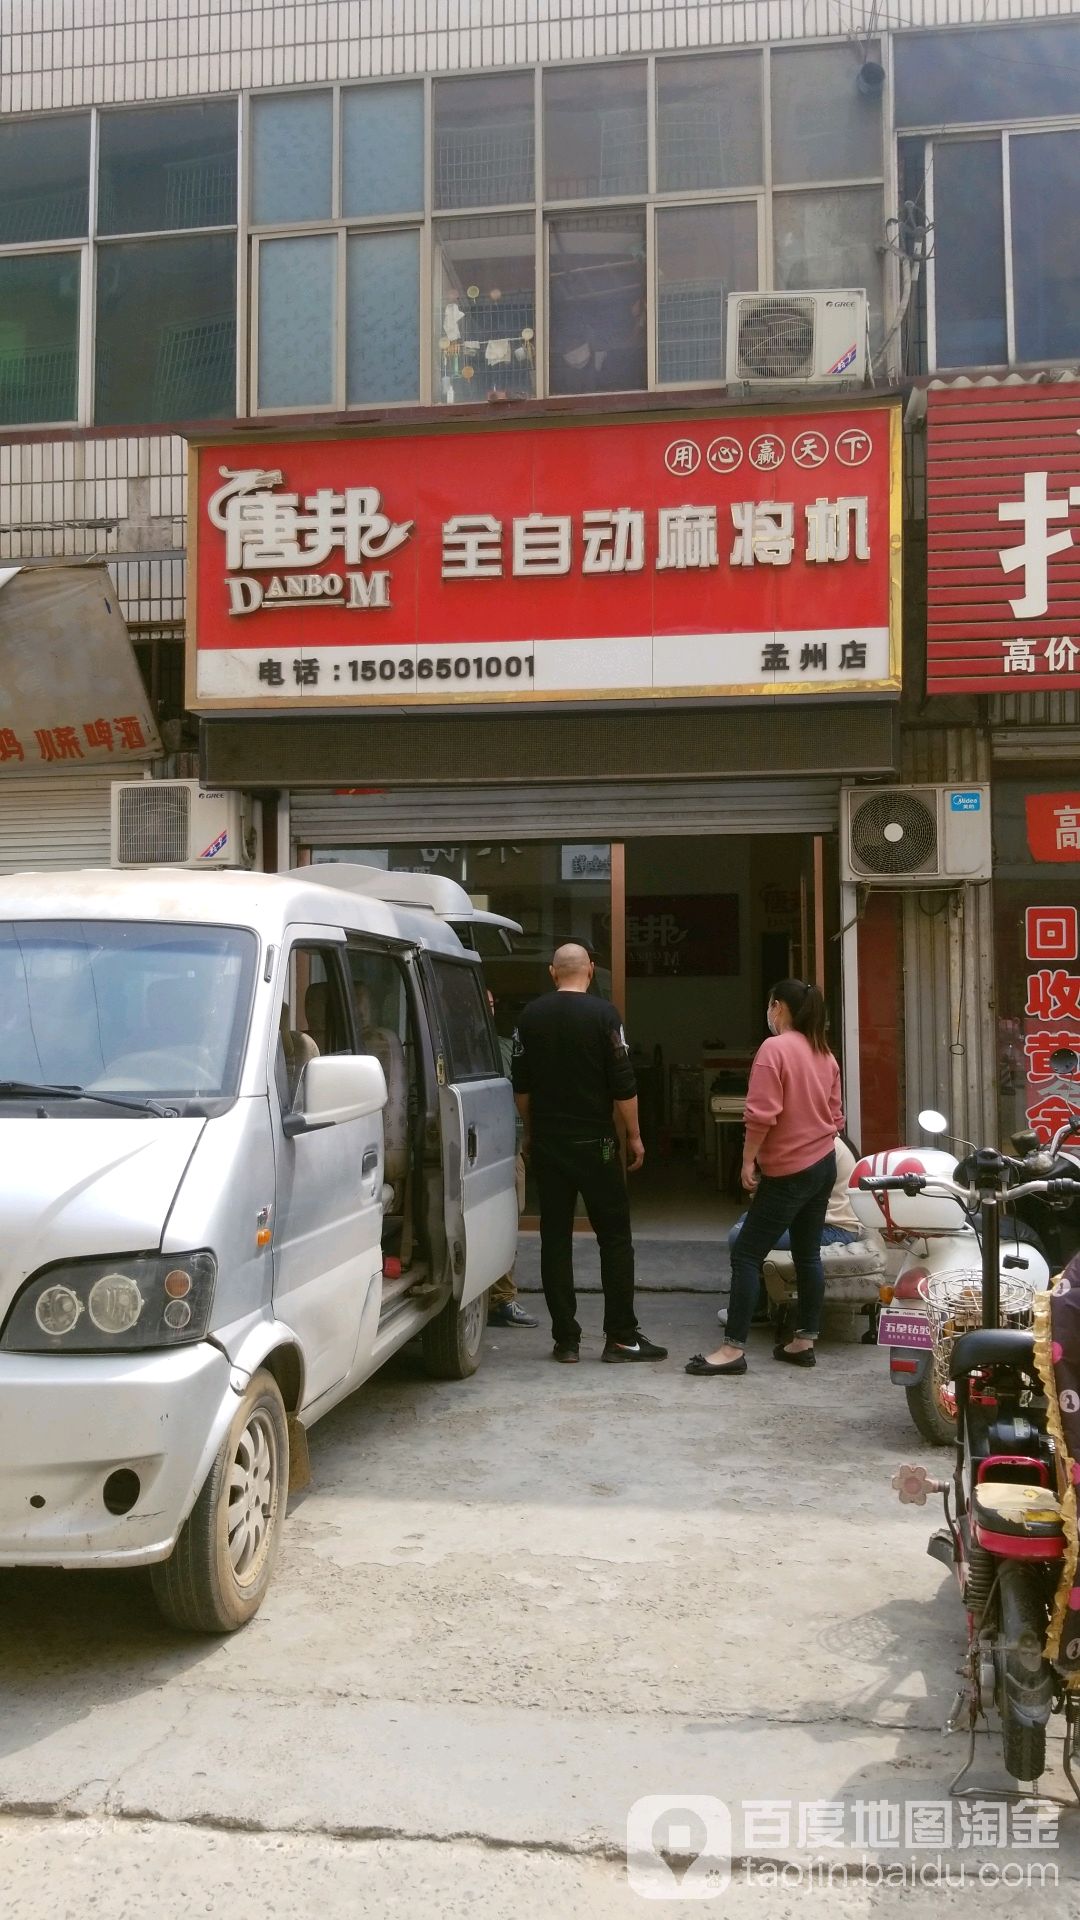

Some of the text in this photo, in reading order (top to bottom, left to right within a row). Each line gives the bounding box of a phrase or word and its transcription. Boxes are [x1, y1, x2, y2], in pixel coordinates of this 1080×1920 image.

[668, 433, 869, 472] 用心赢天下
[208, 466, 414, 569] 唐邦
[441, 496, 871, 577] 全自动麻将机
[224, 570, 392, 615] DANBOM
[760, 639, 867, 672] 孟州店
[1002, 637, 1080, 672] 高价
